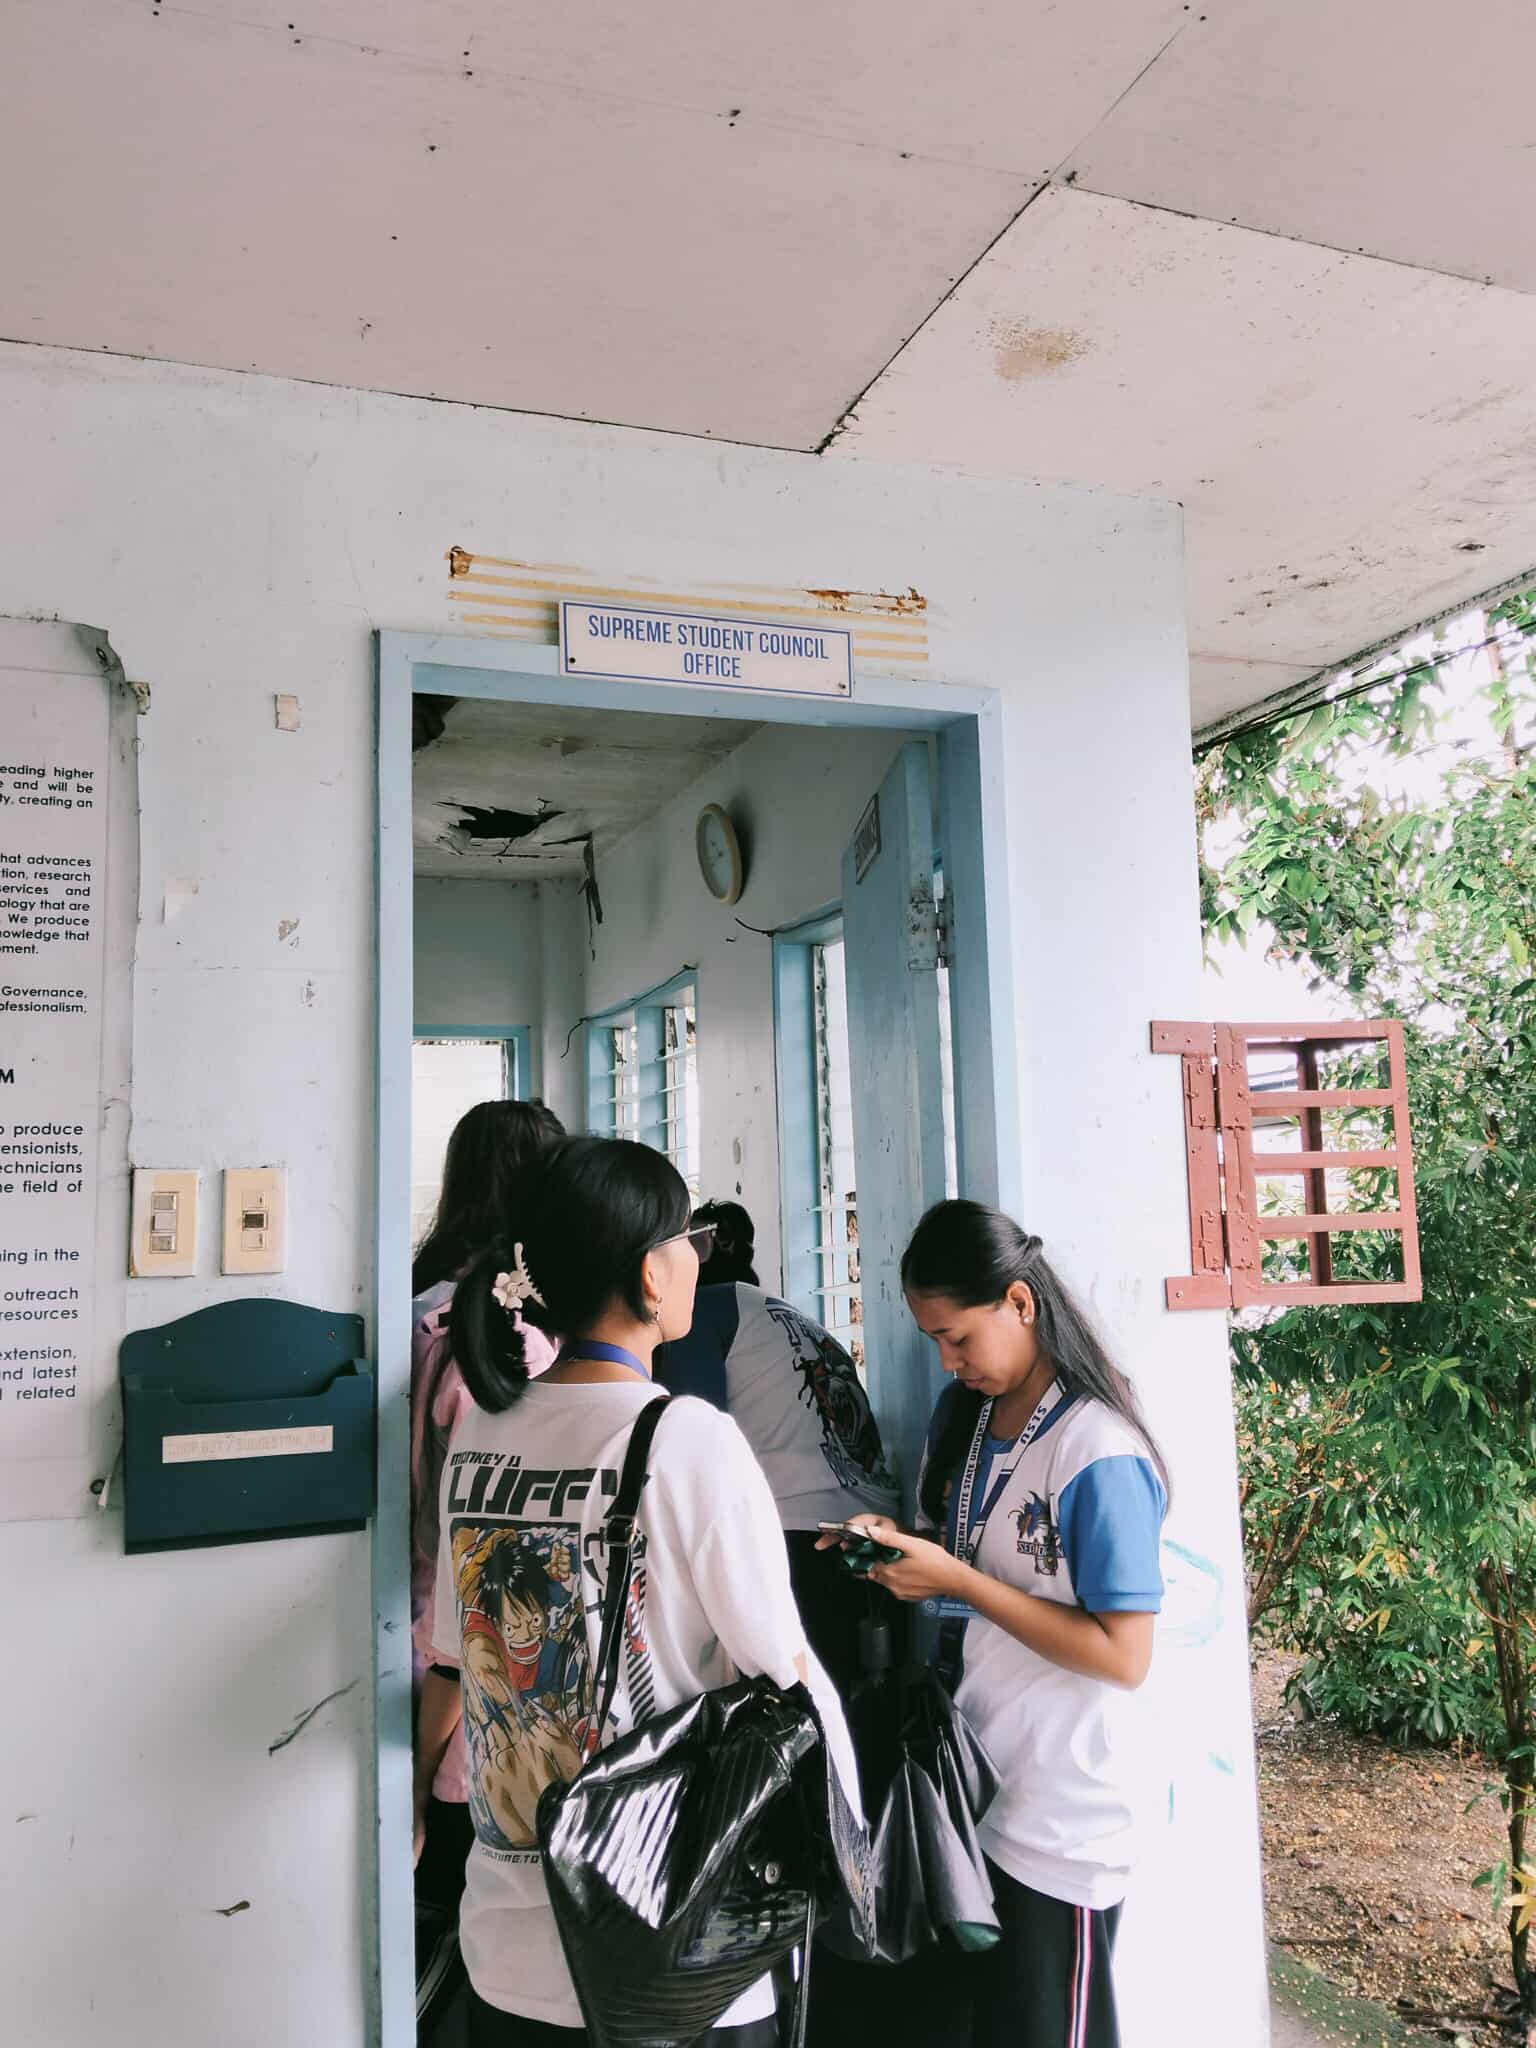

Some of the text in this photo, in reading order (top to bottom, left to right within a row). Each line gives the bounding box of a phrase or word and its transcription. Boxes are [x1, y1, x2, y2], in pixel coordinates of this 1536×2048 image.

[588, 614, 829, 660] SUPREME STUDENT COUNCIL
[683, 652, 741, 678] OFFICE
[53, 766, 94, 780] higher
[13, 780, 39, 791] and
[47, 781, 68, 793] will
[76, 783, 94, 794] be
[18, 795, 73, 809] creating
[76, 799, 93, 808] an
[26, 854, 92, 868] advances
[34, 871, 91, 882] research
[65, 886, 91, 897] and
[40, 899, 65, 910] that
[68, 902, 90, 911] are
[8, 913, 90, 926] We produce
[65, 929, 90, 941] that
[1, 985, 87, 999] Governance,
[13, 1122, 84, 1138] produce
[23, 1180, 58, 1193] field
[66, 1179, 83, 1193] of
[34, 1249, 49, 1262] in
[54, 1248, 80, 1261] the
[4, 1286, 79, 1301] outreach
[32, 1364, 77, 1379] latest
[16, 1384, 76, 1400] related
[1020, 1405, 1048, 1445] SLSU
[962, 1463, 975, 1490] STATE
